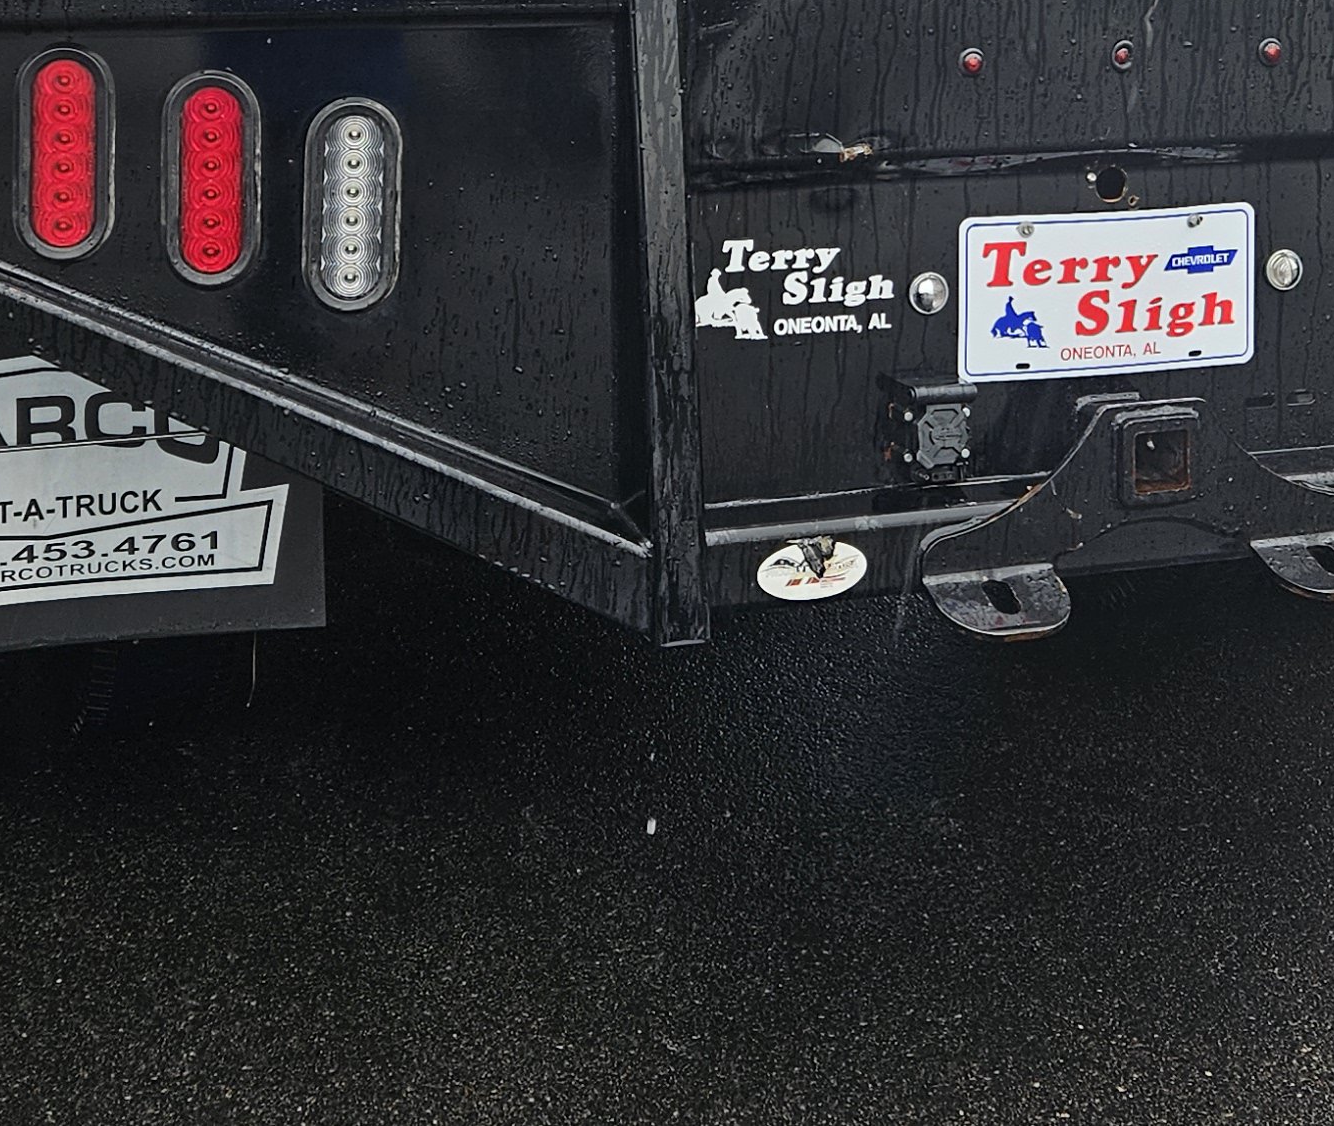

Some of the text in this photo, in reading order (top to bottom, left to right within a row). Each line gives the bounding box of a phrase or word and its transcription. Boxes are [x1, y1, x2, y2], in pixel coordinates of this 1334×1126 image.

[722, 239, 841, 273] Terry
[982, 241, 1230, 289] Terry CHEVROLET
[782, 271, 894, 307] Sligh
[773, 313, 892, 335] ONEONTA, AL
[1074, 289, 1234, 337] Sligh
[1060, 341, 1161, 361] ONEONTA, AL
